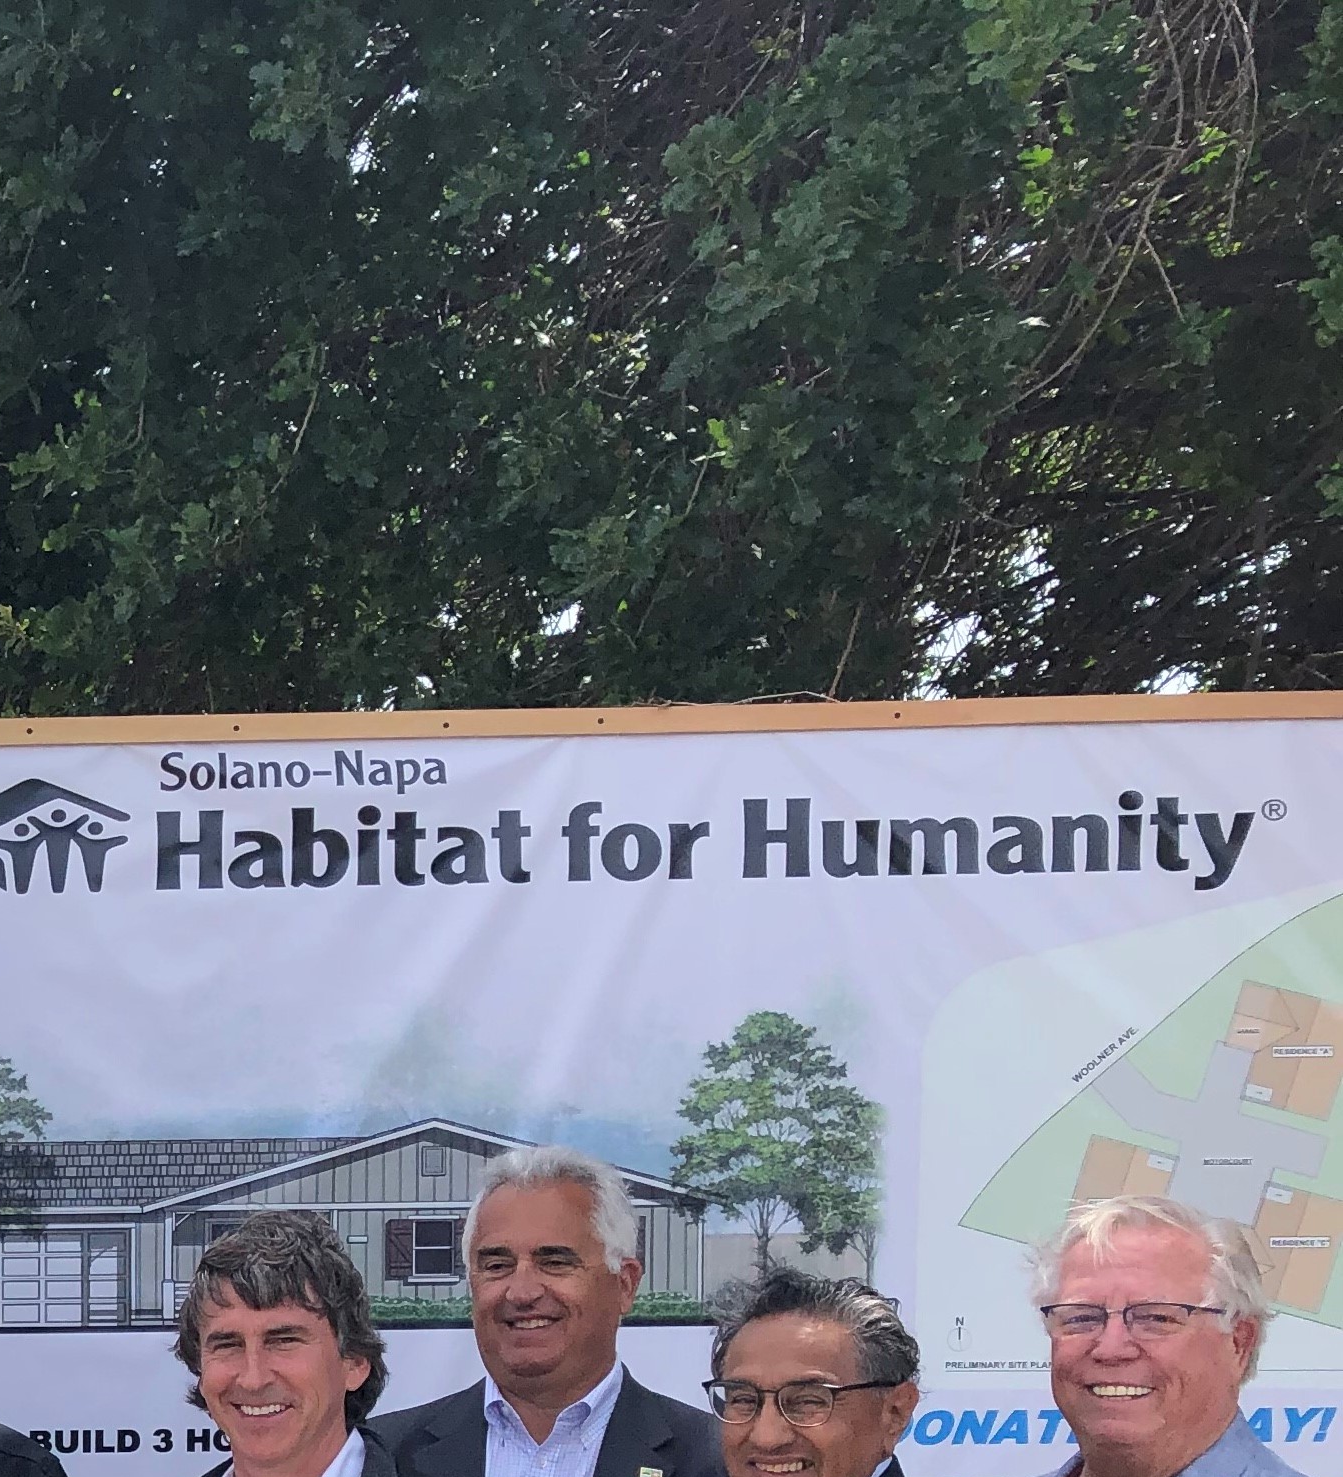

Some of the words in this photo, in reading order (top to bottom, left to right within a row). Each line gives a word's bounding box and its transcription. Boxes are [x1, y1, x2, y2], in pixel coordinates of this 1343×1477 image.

[159, 749, 448, 794] Solano-Napa
[155, 804, 532, 891] Habitat
[561, 800, 711, 883] for
[1071, 1042, 1118, 1084] WOOLNER
[955, 1316, 965, 1326] N
[945, 1361, 1006, 1369] PRELIMINARY
[1008, 1361, 1028, 1369] SITE
[28, 1429, 141, 1454] BUILD
[152, 1428, 174, 1453] 3
[896, 1408, 1079, 1447] ONAT
[1252, 1406, 1338, 1443] AY!
